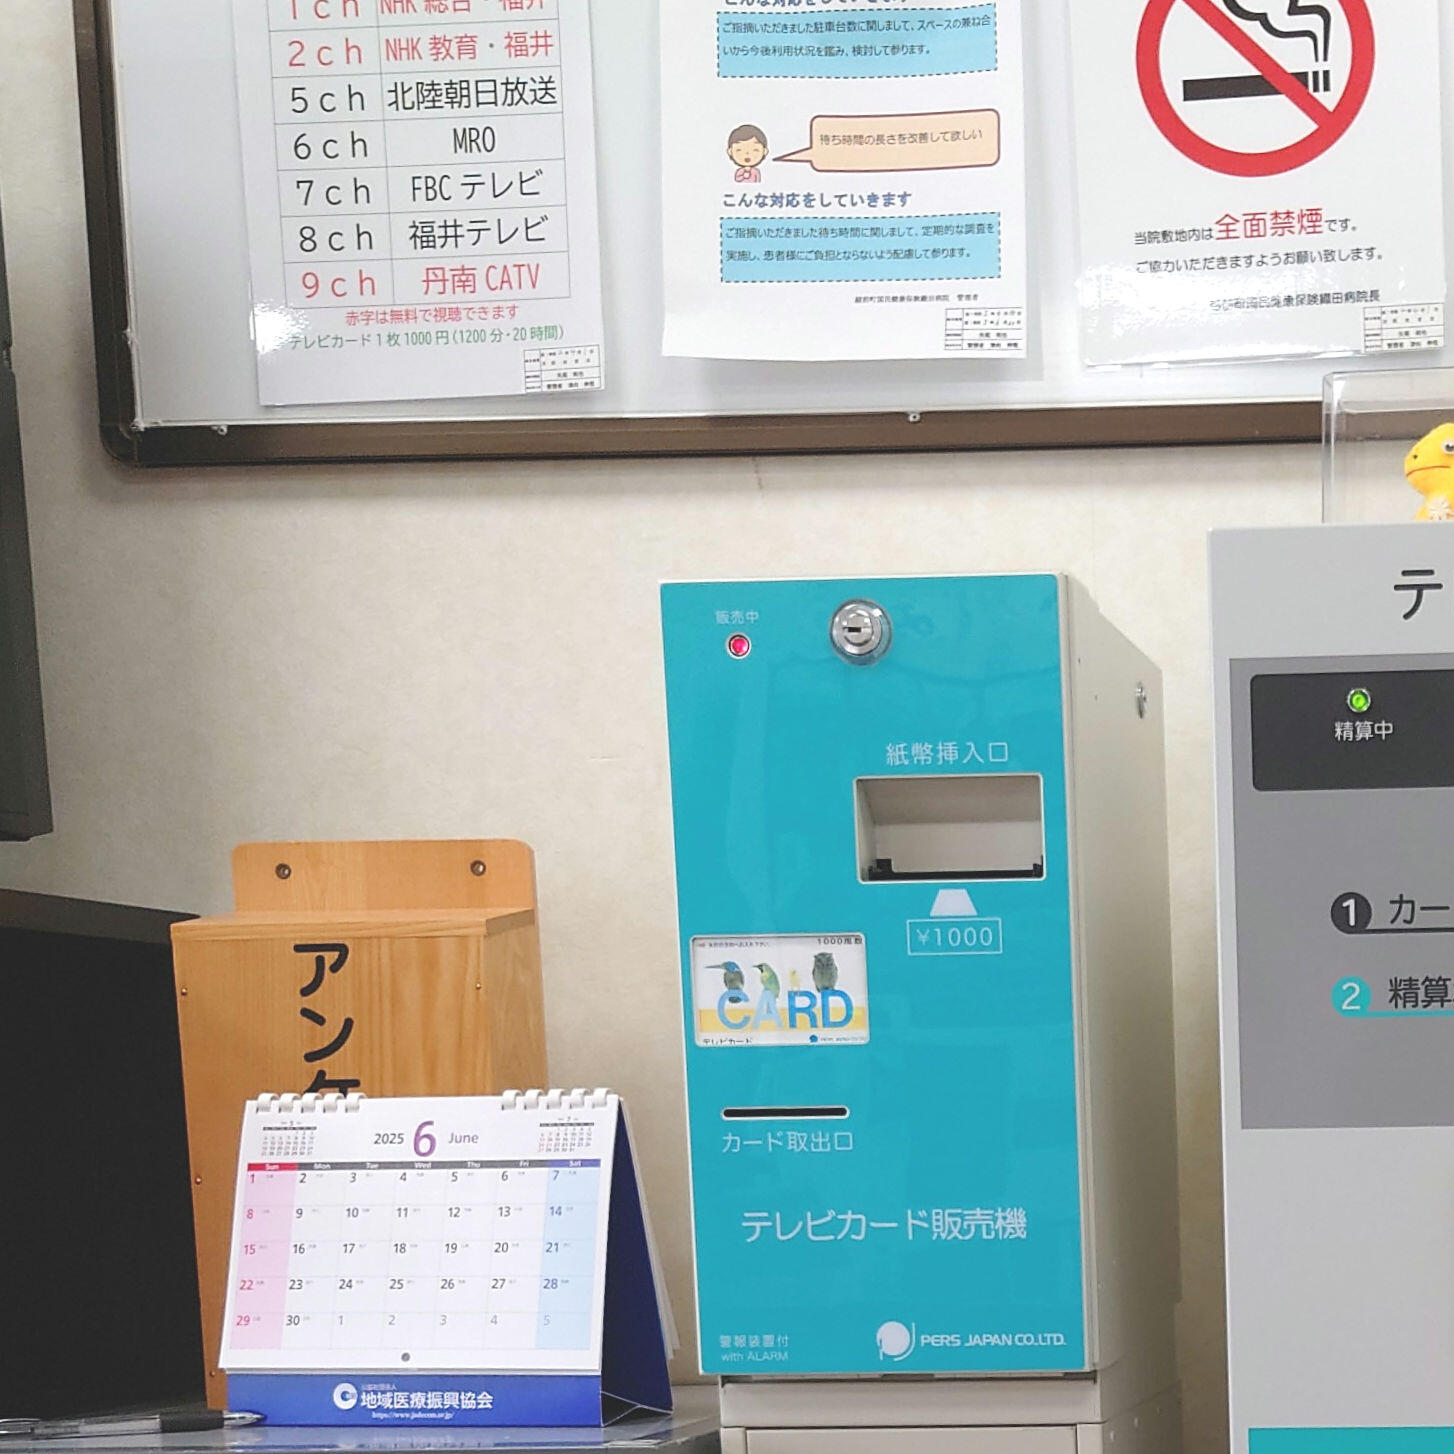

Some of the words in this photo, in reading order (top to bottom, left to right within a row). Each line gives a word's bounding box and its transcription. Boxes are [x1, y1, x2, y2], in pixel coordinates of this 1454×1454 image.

[387, 76, 558, 112] 北陸朝日放送
[453, 126, 496, 154] MRO
[820, 129, 983, 147] 待ち時間の長さを改善して欲しい
[723, 191, 913, 209] こんな対応をしていきます
[408, 214, 549, 250] 福井テレビ
[346, 305, 519, 326] 赤字は無料で視聴できます
[715, 610, 759, 625] 販売中
[1334, 720, 1393, 741] 精算中
[885, 741, 1009, 766] 紙幣挿入口
[916, 926, 993, 948] ¥1000
[717, 989, 854, 1029] CARD
[373, 1133, 405, 1145] 2025
[413, 1120, 437, 1157] 6
[448, 1132, 479, 1145] June
[721, 1131, 854, 1153] カード取出口
[250, 1173, 255, 1184] 1
[299, 1173, 307, 1183] 2
[350, 1173, 357, 1183] 3
[400, 1172, 407, 1182] 4
[451, 1172, 458, 1182] 5
[501, 1171, 509, 1181] 6
[553, 1170, 559, 1180] 7
[247, 1208, 254, 1219] 8
[296, 1208, 303, 1219] 9
[346, 1207, 359, 1218] 10
[397, 1208, 408, 1218] 11
[448, 1207, 460, 1218] 12
[498, 1207, 511, 1217] 13
[550, 1206, 562, 1216] 14
[742, 1207, 1028, 1243] テレビカード販売機
[244, 1244, 256, 1254] 15
[293, 1244, 305, 1254] 16
[343, 1243, 355, 1253] 17
[393, 1243, 407, 1253] 18
[445, 1243, 457, 1253] 19
[494, 1242, 509, 1253] 20
[545, 1242, 559, 1253] 21
[239, 1280, 254, 1290] 22
[289, 1279, 303, 1290] 23
[339, 1279, 353, 1289] 24
[389, 1279, 404, 1289] 25
[440, 1278, 455, 1289] 26
[491, 1278, 506, 1289] 27
[543, 1278, 558, 1289] 28
[236, 1315, 250, 1326] 29
[286, 1315, 300, 1326] 30
[339, 1315, 344, 1325] 1
[388, 1315, 395, 1325] 2
[440, 1315, 447, 1325] 3
[490, 1315, 498, 1325] 4
[544, 1315, 550, 1325] 5
[921, 1334, 961, 1347] PERS
[965, 1333, 1013, 1346] JAPAN
[722, 1352, 744, 1361] with
[747, 1351, 789, 1361] ALARM
[361, 1391, 494, 1410] 地域医療振興協会
